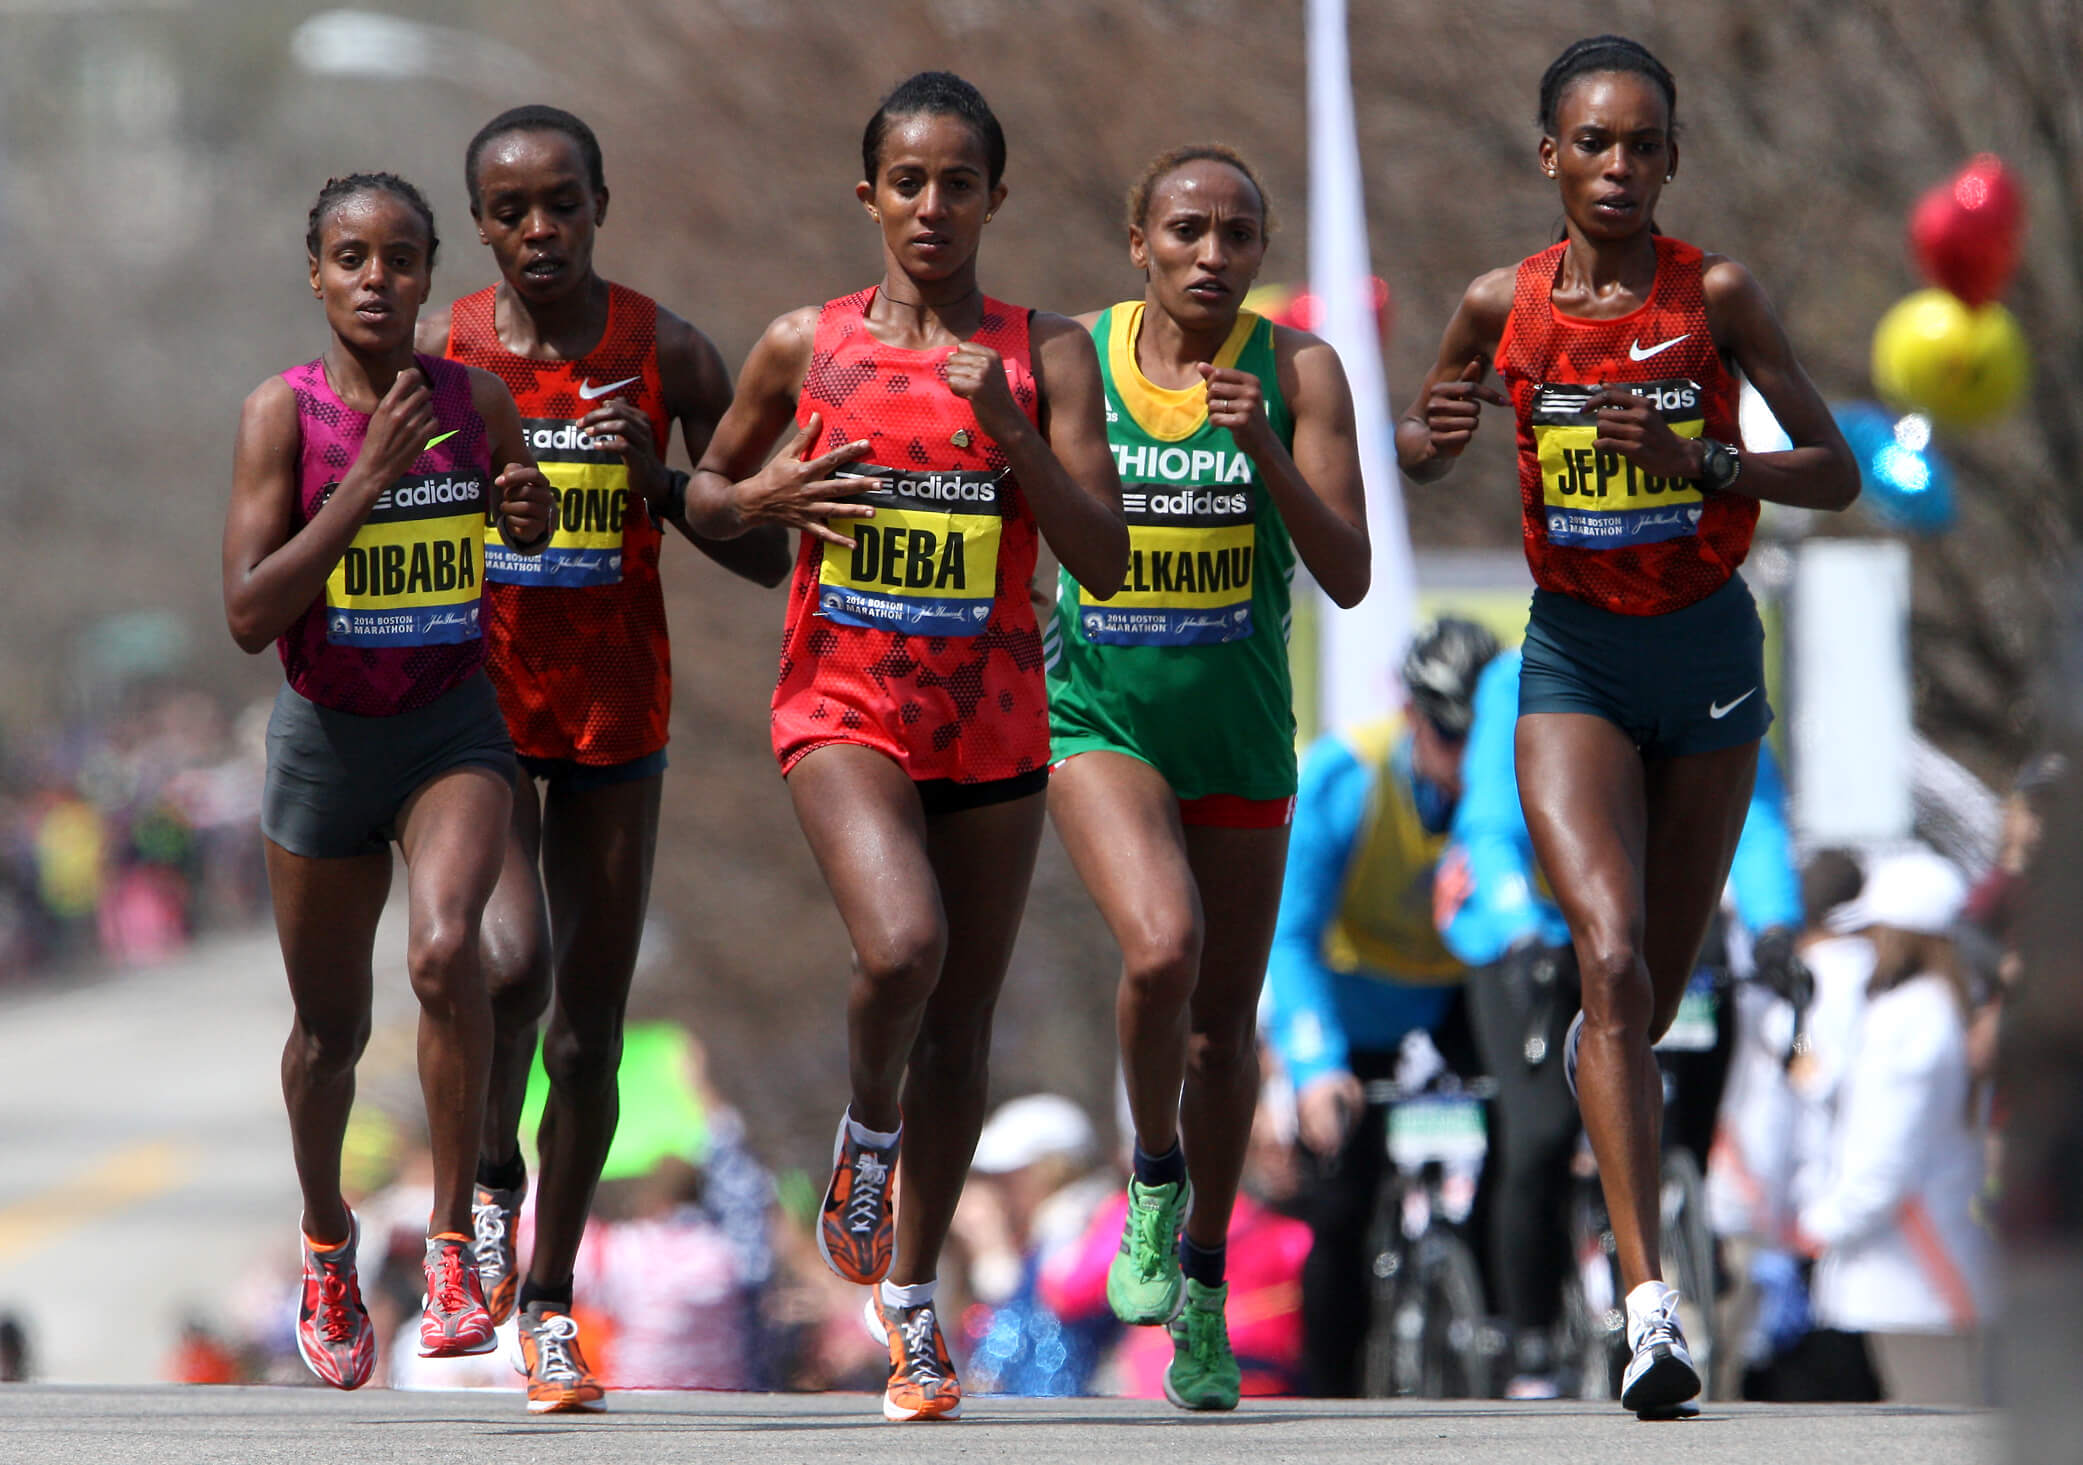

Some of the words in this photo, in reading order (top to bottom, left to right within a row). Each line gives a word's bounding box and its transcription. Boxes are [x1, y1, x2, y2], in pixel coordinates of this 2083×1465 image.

[395, 478, 480, 508] adidas
[898, 475, 996, 502] adidas
[1150, 490, 1248, 515] adidas
[1570, 524, 1623, 536] MARATHON
[1587, 517, 1622, 527] BOSTON
[851, 524, 966, 590] DEBA
[344, 537, 475, 597] DIBABA
[846, 595, 866, 606] 2014
[867, 597, 904, 611] BOSTON
[353, 616, 374, 625] 2014
[377, 615, 413, 625] BOSTON
[846, 604, 904, 621] MARATHON
[1107, 614, 1127, 623] 2014
[1130, 615, 1166, 624] BOSTON
[353, 624, 414, 635] MARATHON
[1107, 623, 1167, 633] MARATHON
